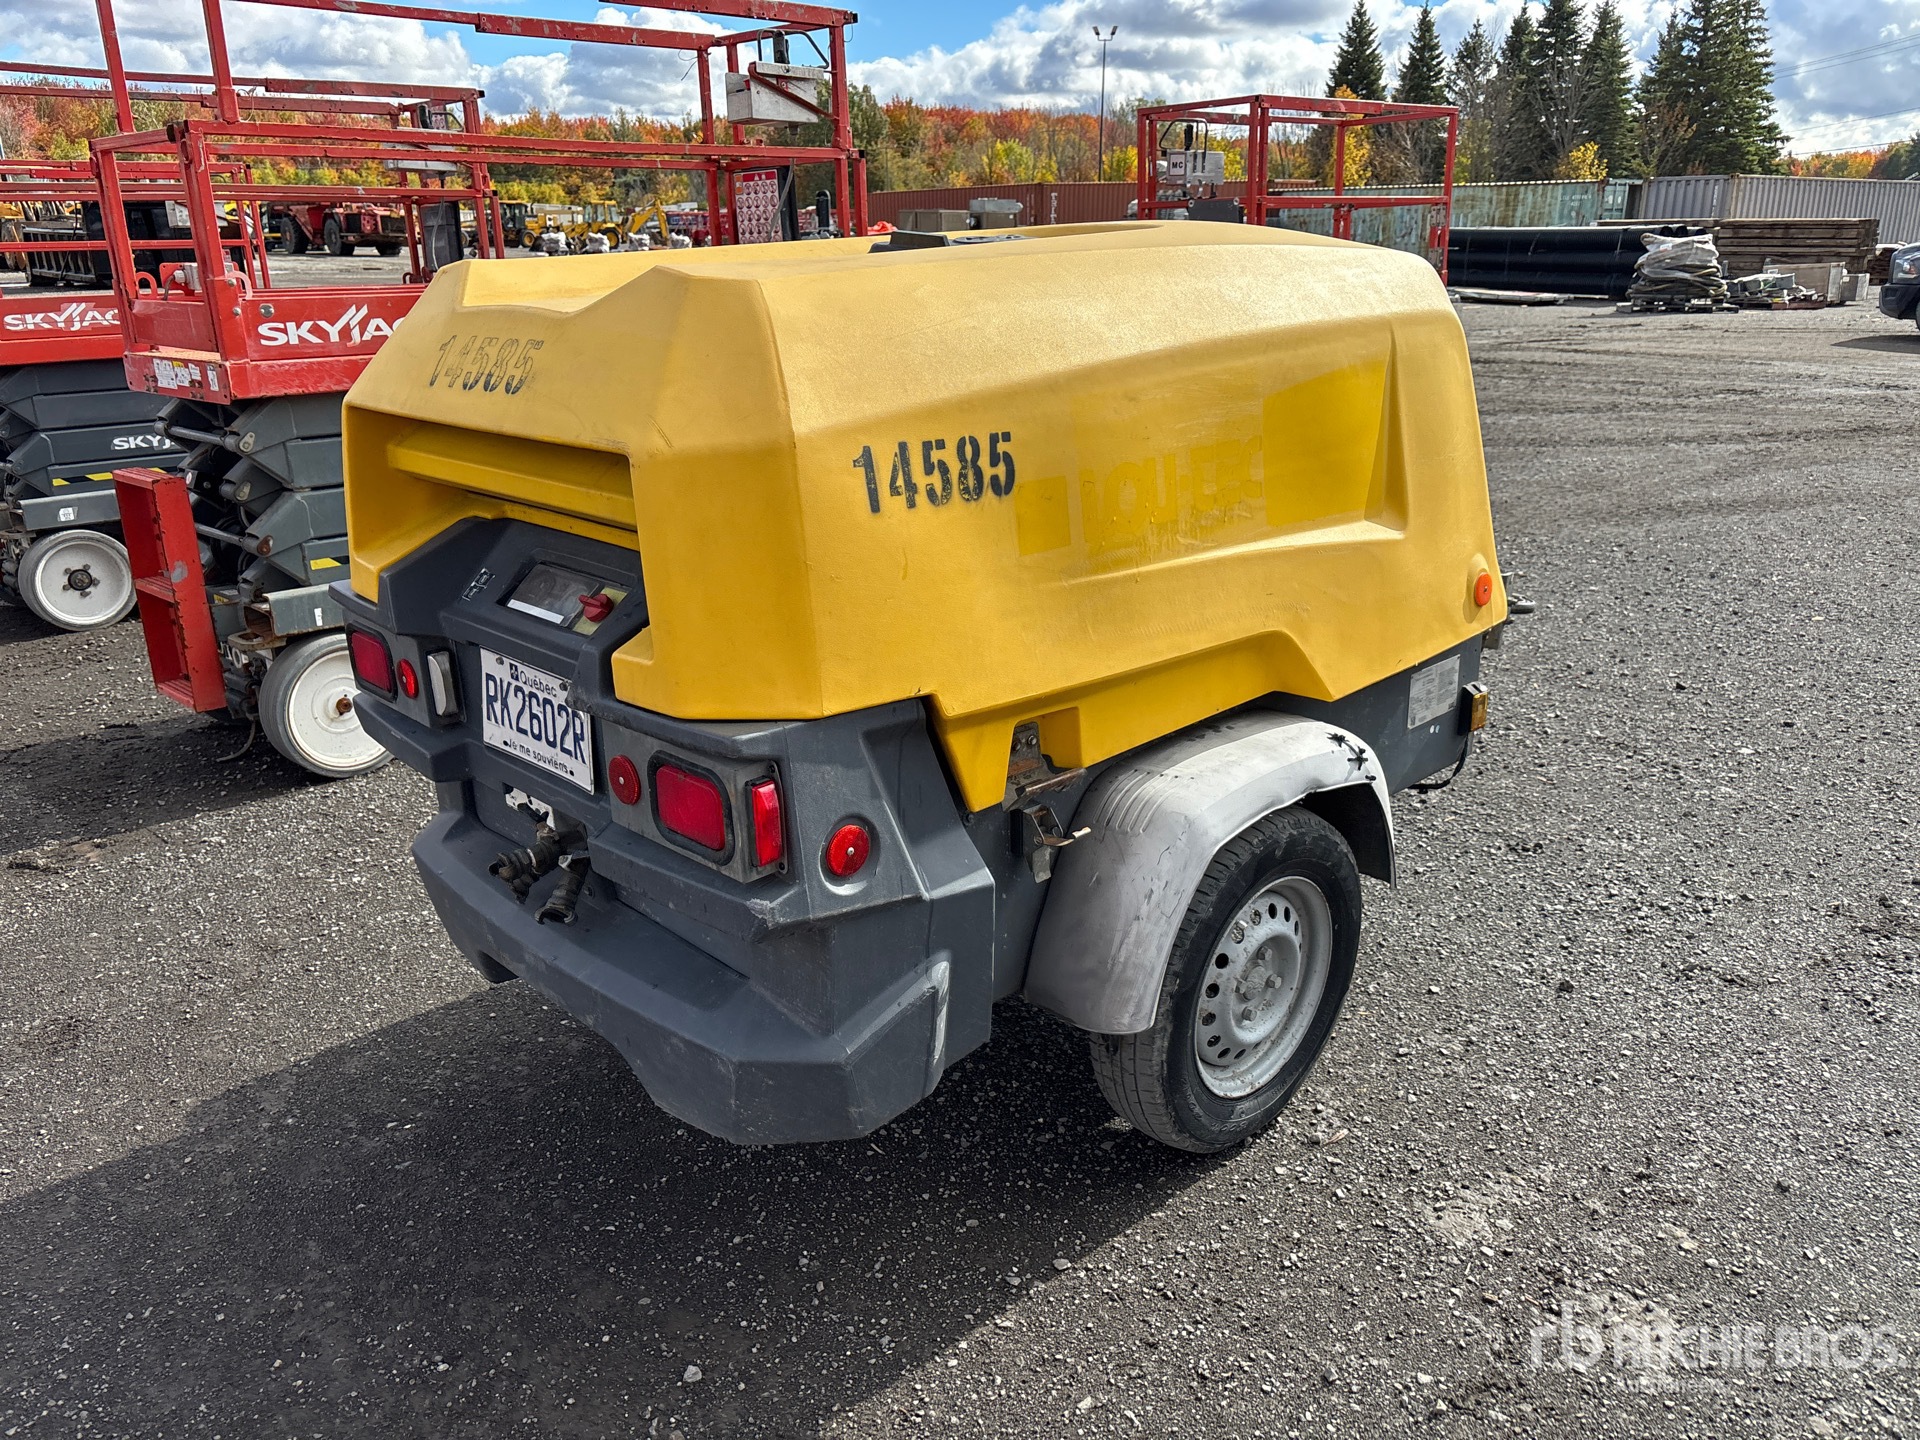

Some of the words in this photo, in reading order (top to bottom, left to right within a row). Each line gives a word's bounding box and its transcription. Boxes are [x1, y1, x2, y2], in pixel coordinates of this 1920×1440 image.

[1171, 161, 1184, 169] MC
[257, 303, 406, 347] SKYJA
[429, 335, 544, 395] 14585
[112, 434, 175, 450] SKYJ
[852, 431, 1015, 514] 14585
[519, 670, 557, 698] Québec
[485, 672, 587, 765] RK2602R
[519, 743, 531, 757] me
[532, 750, 569, 774] souviens
